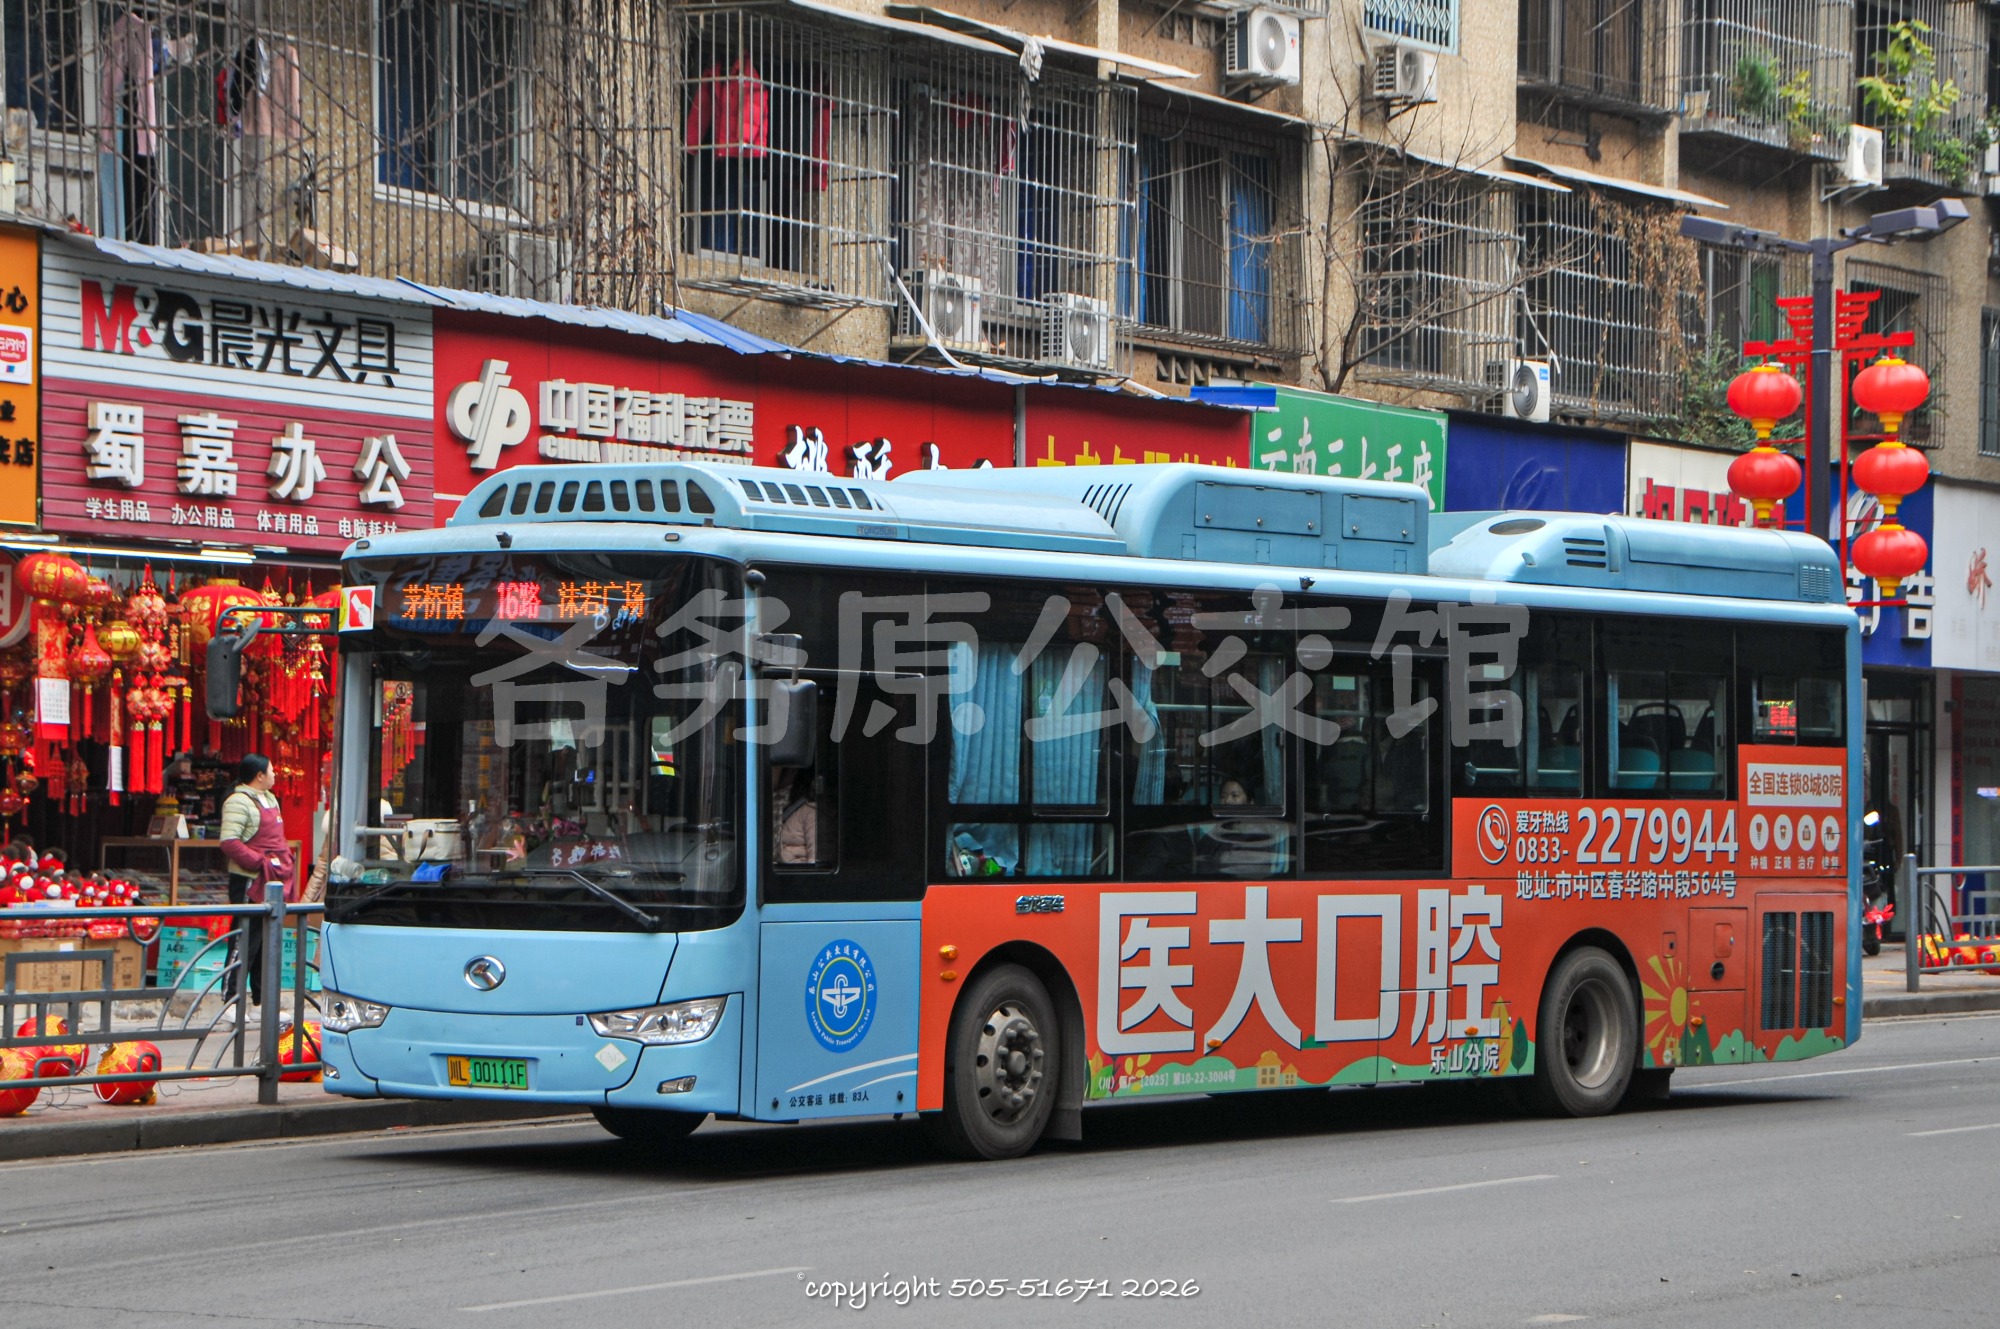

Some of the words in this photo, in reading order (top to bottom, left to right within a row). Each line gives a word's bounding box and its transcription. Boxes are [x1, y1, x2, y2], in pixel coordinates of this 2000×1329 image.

[80, 279, 204, 362] M&G
[210, 300, 400, 388] 晨光文具
[539, 379, 754, 452] 中国福利彩票
[83, 402, 411, 509] 蜀嘉办公
[539, 435, 601, 462] CHINA
[85, 498, 151, 522] 学生用品
[171, 503, 236, 529] 办公用品
[256, 510, 319, 535] 体育用品
[338, 517, 398, 539] 电脑耗材
[401, 583, 465, 620] 茅桥镇
[497, 581, 543, 619] 16路
[558, 580, 646, 619] 沫若广场
[1749, 771, 1843, 797] 全国连锁8城8院
[1515, 810, 1569, 835] 爱牙热线
[1515, 836, 1569, 864] 0833-
[1577, 807, 1739, 864] 2279944
[1096, 884, 1504, 1056] 医大口腔
[1430, 1042, 1500, 1075] 乐山分院
[789, 1095, 823, 1108] 公交客运
[852, 1090, 870, 1102] 83人
